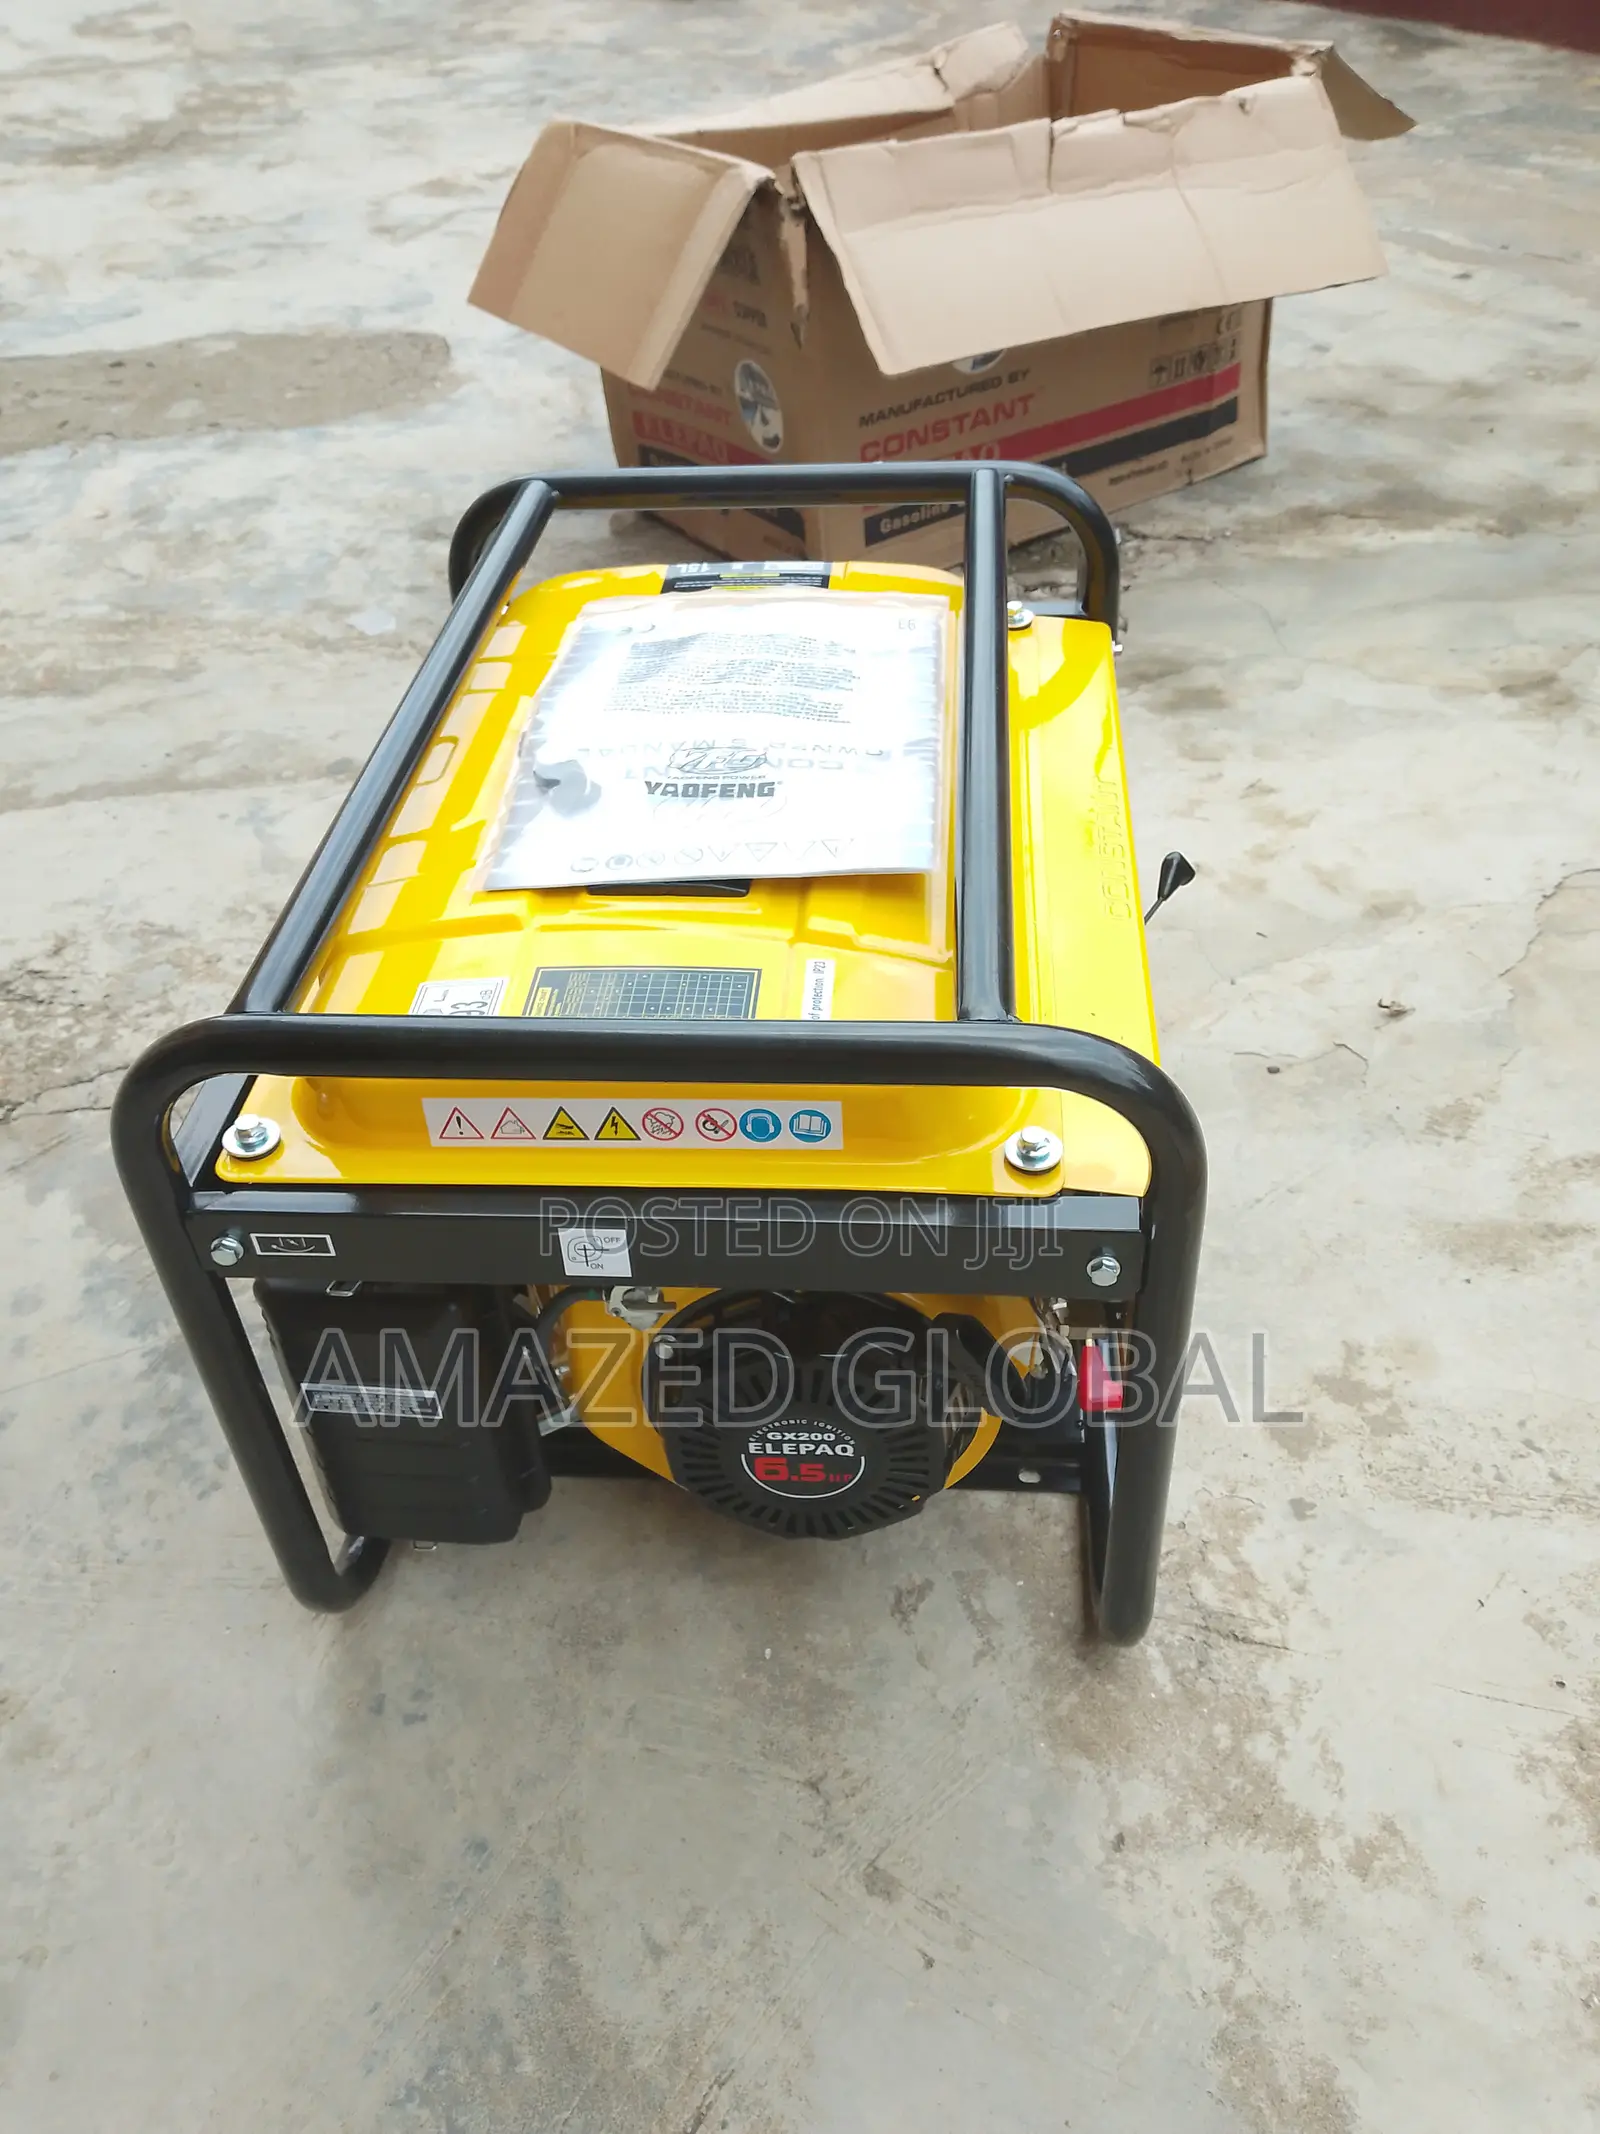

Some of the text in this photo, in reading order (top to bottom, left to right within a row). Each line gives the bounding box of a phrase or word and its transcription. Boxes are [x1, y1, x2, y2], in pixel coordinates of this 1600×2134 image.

[859, 368, 1031, 428] MANUFACTURED BY
[860, 393, 1035, 462] CONSTANT
[879, 504, 950, 534] Gasoline
[644, 781, 776, 798] YAOFENG
[812, 961, 826, 974] IP23
[603, 1236, 621, 1244] OFF
[748, 1419, 856, 1446] ELECTRONIC IGNITION
[766, 1432, 836, 1442] GX200
[748, 1442, 855, 1457] ELEPAQ
[754, 1457, 826, 1483] 6.5
